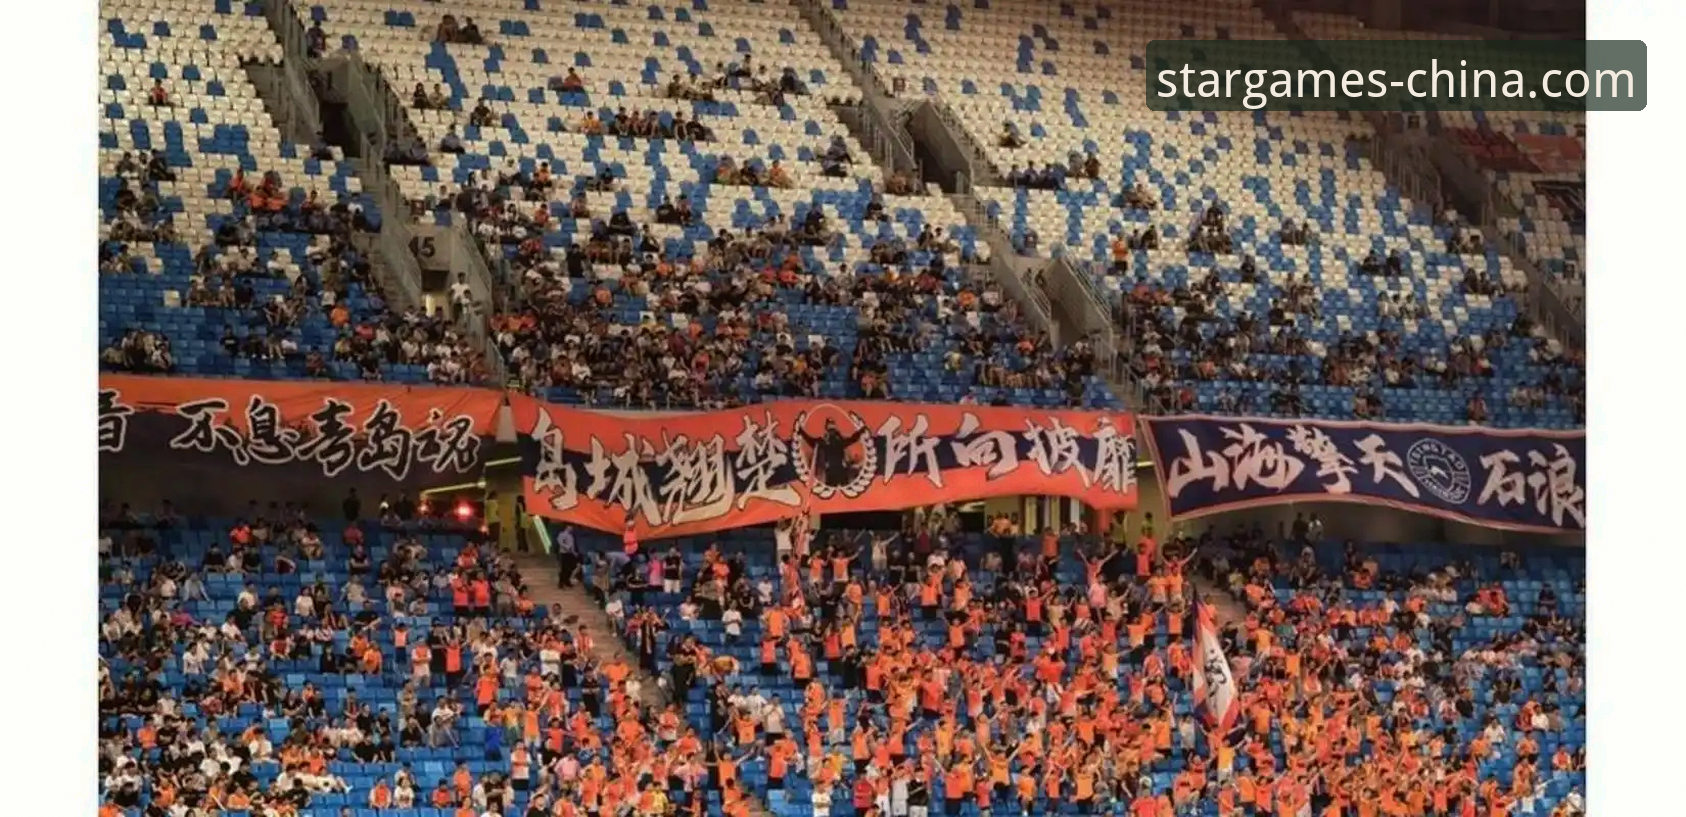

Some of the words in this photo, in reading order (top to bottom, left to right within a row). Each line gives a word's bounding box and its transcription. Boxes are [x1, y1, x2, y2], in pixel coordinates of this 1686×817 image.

[878, 413, 1136, 494] 所向披靡
[1168, 424, 1420, 498] 山海擎天
